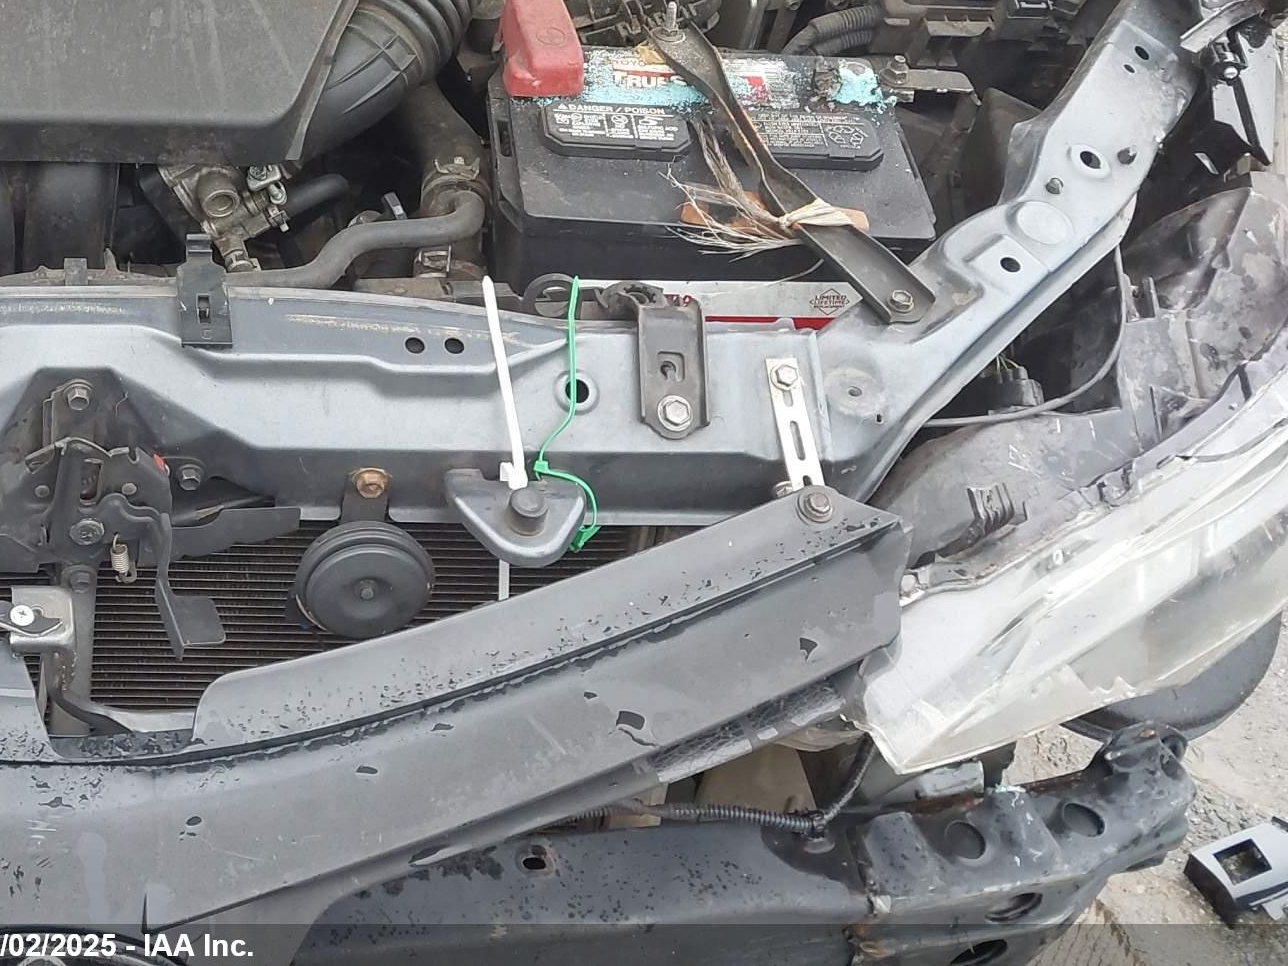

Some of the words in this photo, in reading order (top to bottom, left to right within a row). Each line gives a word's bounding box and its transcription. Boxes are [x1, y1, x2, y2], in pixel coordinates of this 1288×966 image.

[613, 71, 688, 90] TRUES
[567, 103, 614, 113] DANGER
[624, 106, 666, 116] POISON
